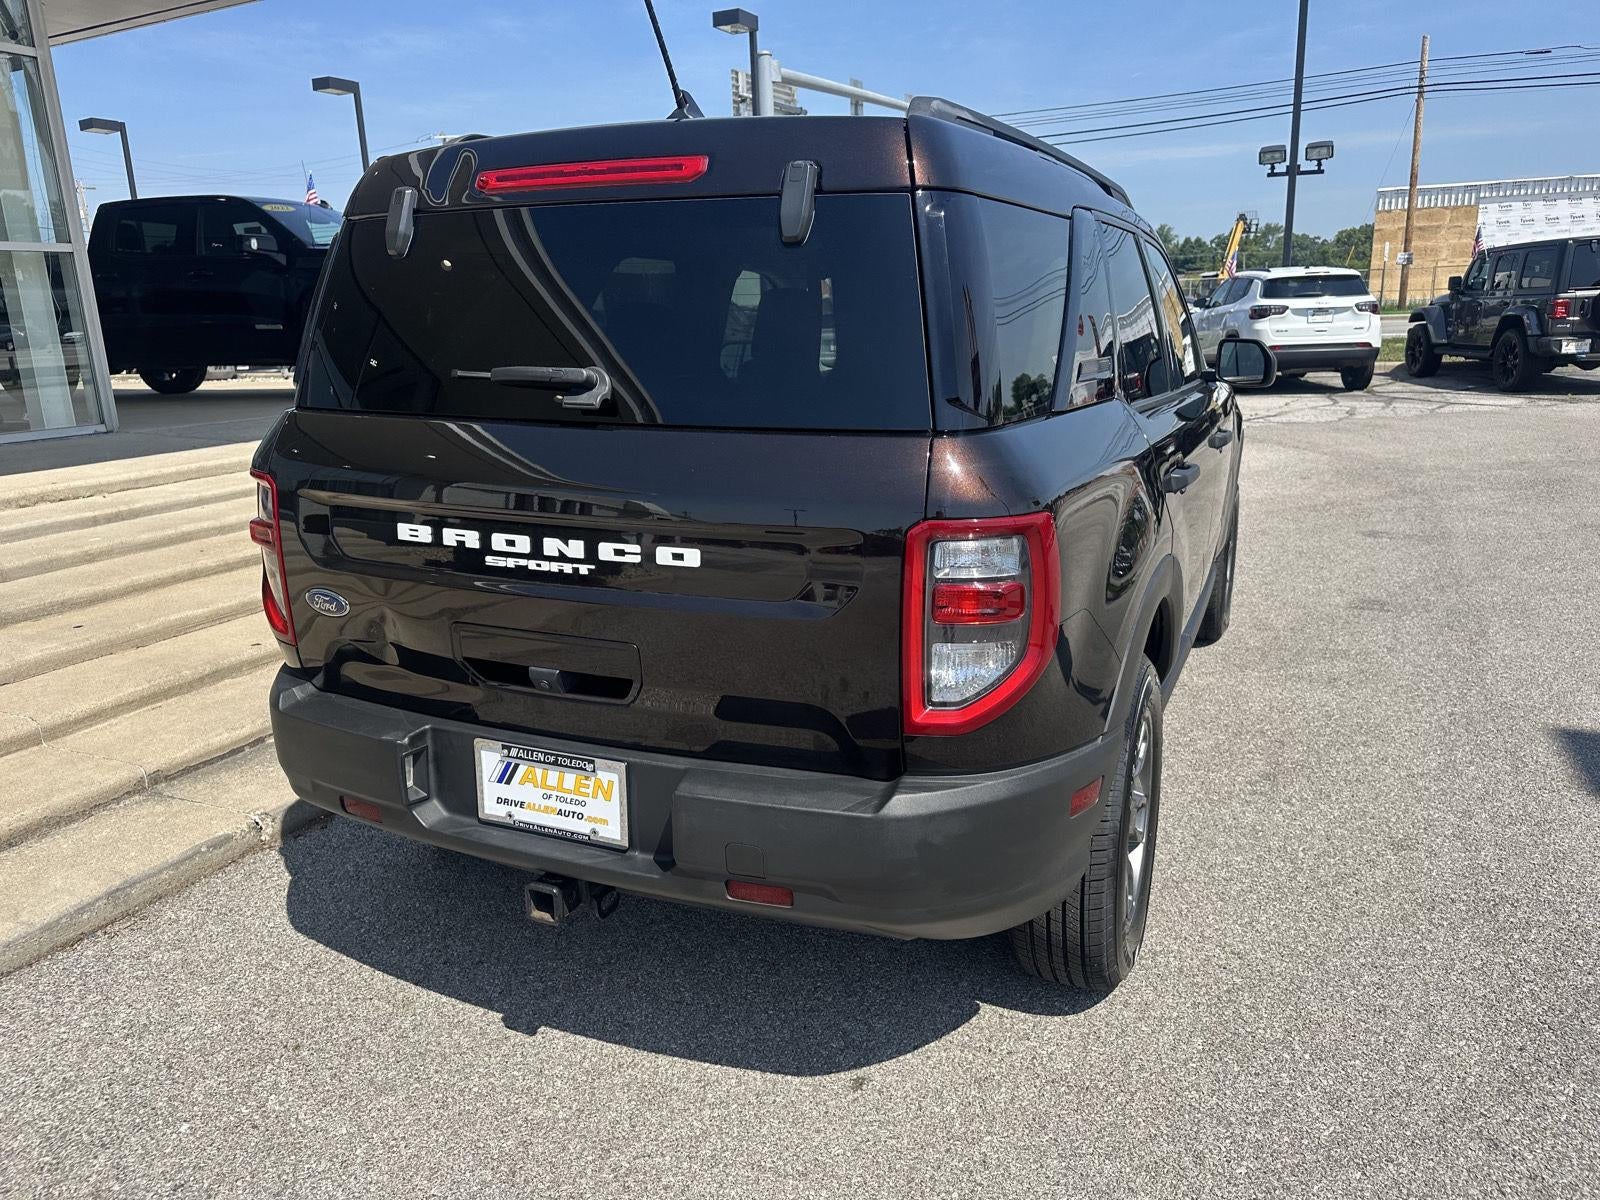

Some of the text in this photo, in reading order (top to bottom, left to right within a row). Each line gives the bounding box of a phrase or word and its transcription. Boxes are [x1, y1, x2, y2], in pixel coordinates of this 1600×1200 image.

[396, 522, 702, 569] BRONCO
[484, 555, 596, 575] SPORT
[314, 594, 337, 612] Ford
[517, 749, 588, 769] ALLEN OF TOLEDO
[518, 765, 615, 802] ALLEN
[541, 792, 587, 808] OF TOLEDO
